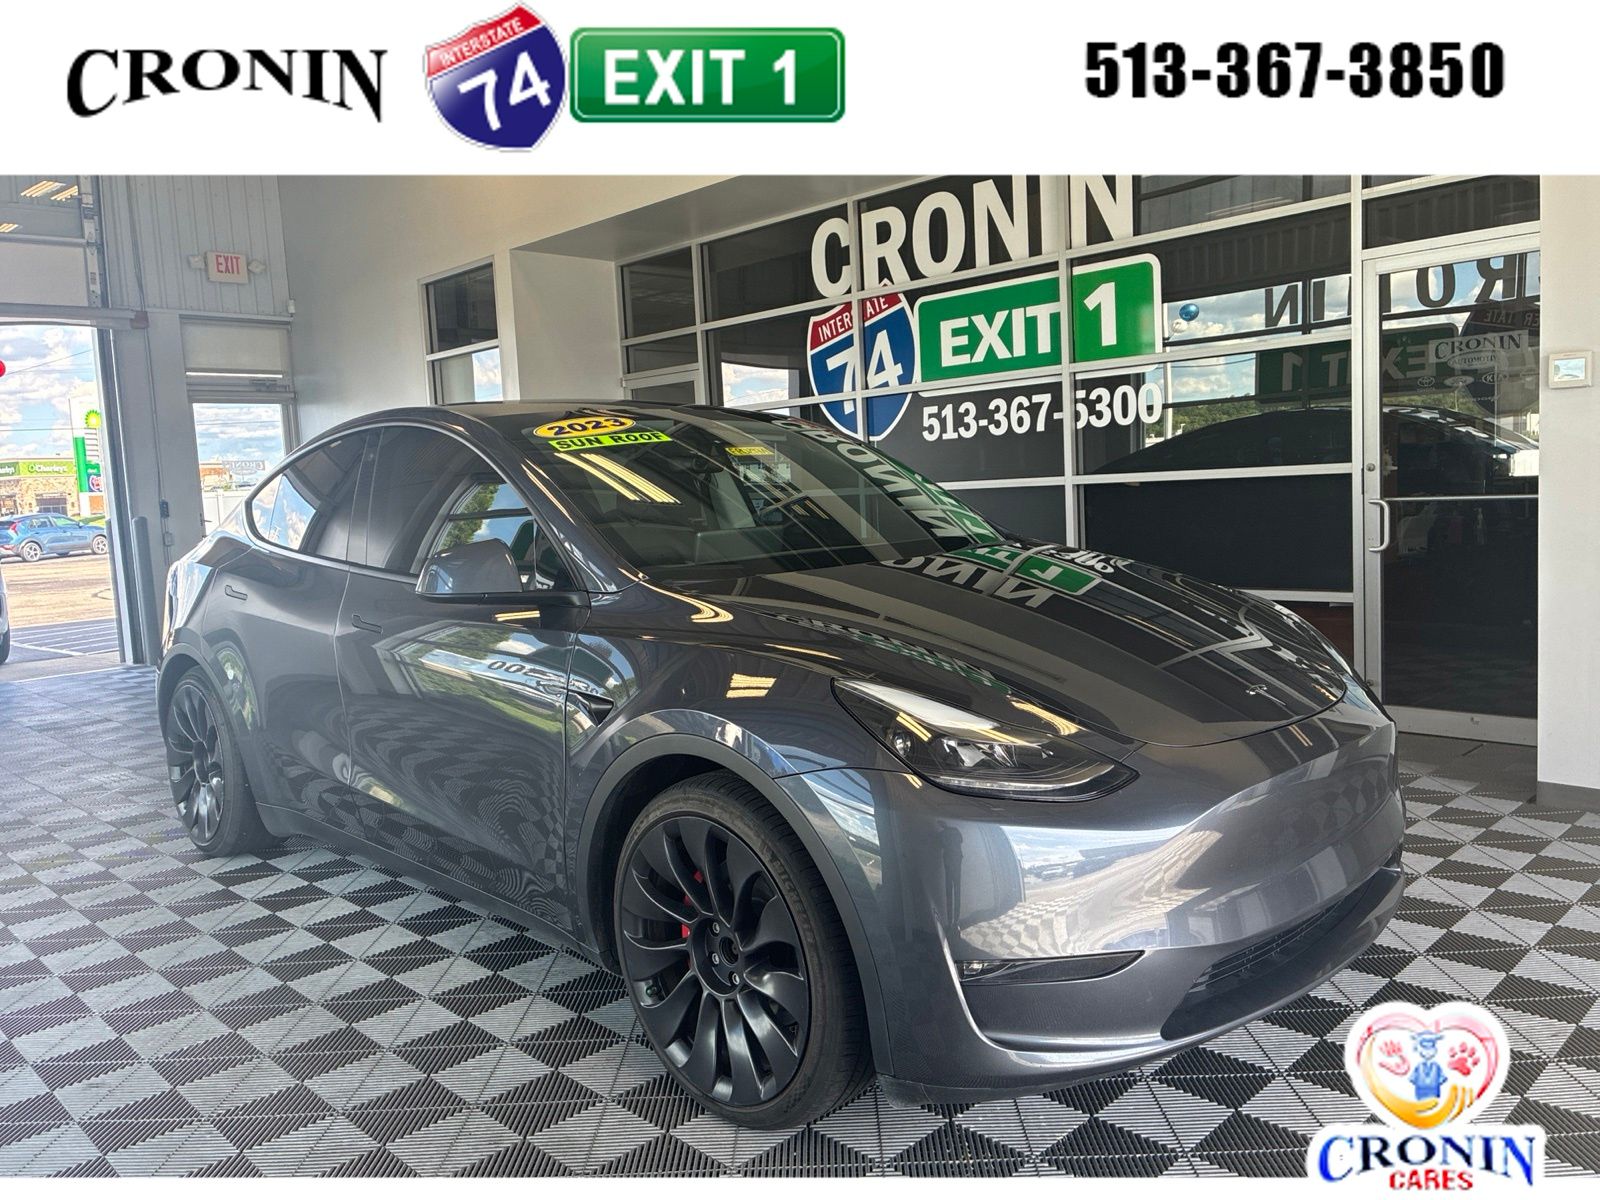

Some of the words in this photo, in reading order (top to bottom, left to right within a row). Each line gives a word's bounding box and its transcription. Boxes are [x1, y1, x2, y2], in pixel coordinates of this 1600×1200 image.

[811, 175, 1134, 298] CRONIN
[215, 254, 241, 275] EXIT
[818, 297, 889, 342] INTERATE
[941, 302, 1061, 367] EXIT
[1084, 282, 1117, 347] 1
[1435, 333, 1522, 360] CRONIN
[826, 329, 903, 415] 74
[547, 418, 626, 436] 2023
[922, 383, 1163, 442] 513-367-5300
[555, 437, 604, 450] SUN
[609, 431, 665, 443] ROOF
